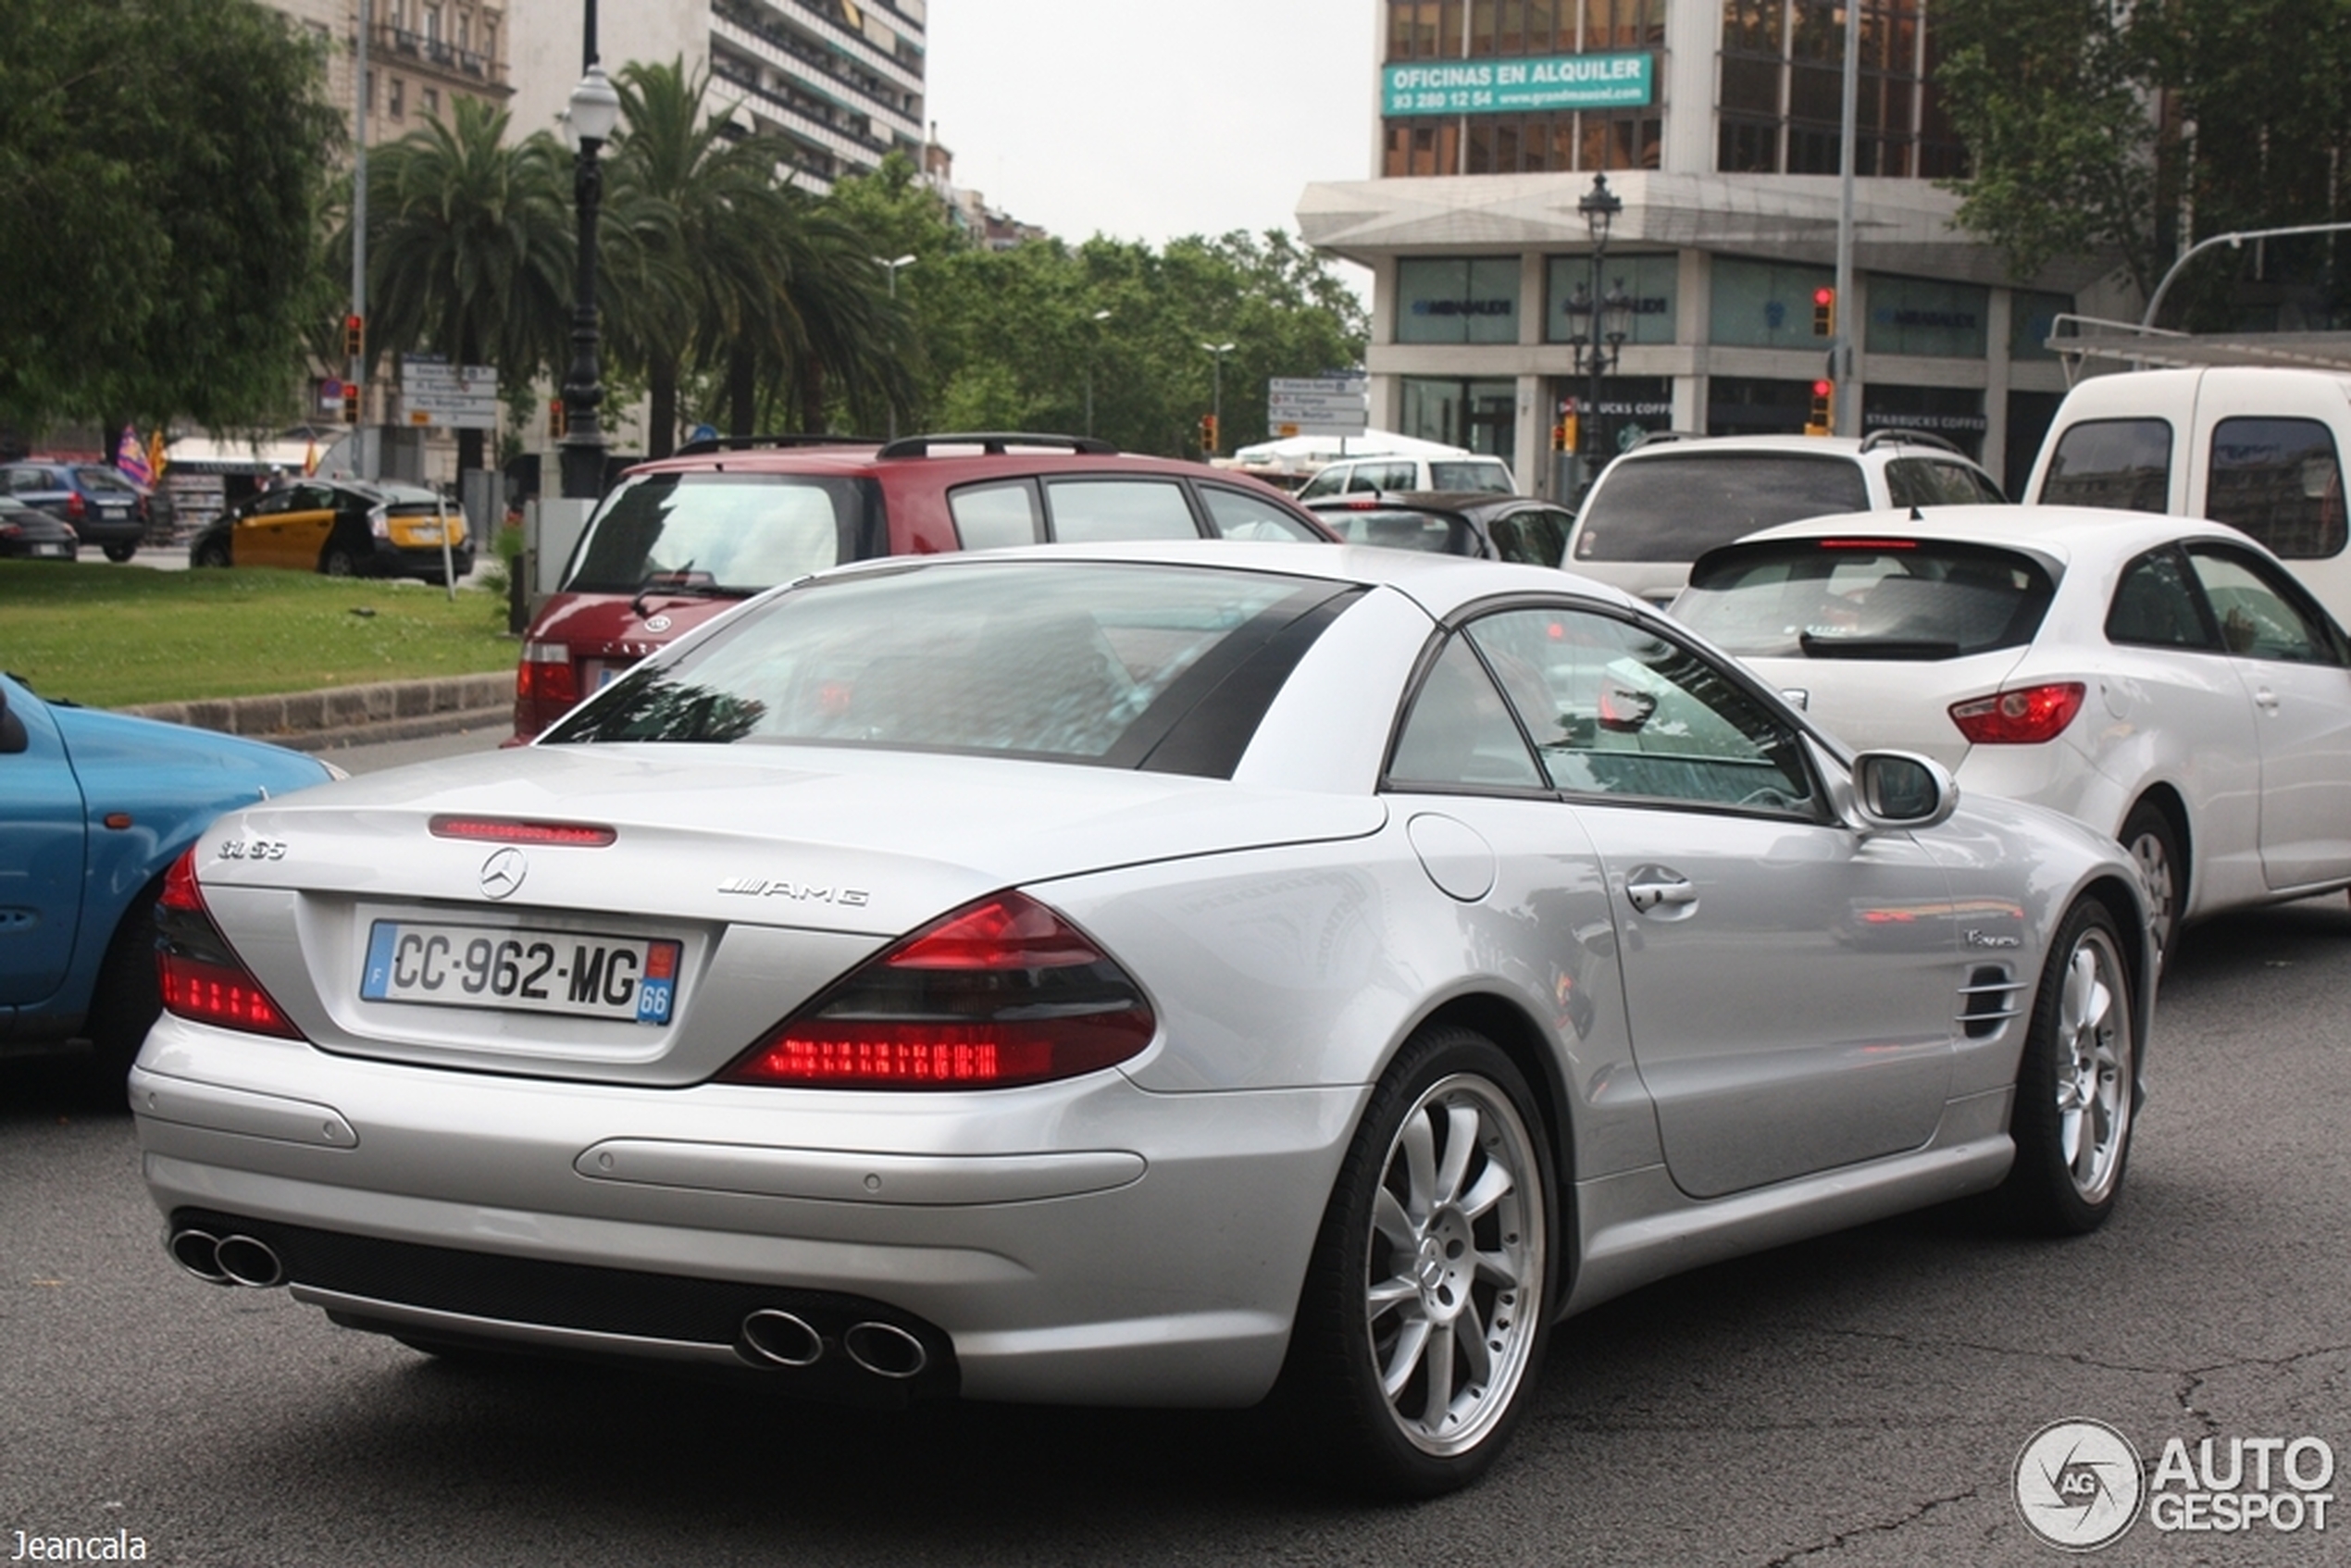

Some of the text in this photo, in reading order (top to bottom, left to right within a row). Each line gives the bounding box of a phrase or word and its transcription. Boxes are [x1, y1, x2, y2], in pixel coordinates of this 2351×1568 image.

[1393, 59, 1641, 90] OFICINAS EN ALQUILER
[1393, 93, 1412, 109] 93
[1450, 91, 1470, 106] 12
[1472, 90, 1492, 106] 54
[218, 840, 245, 860] SL
[765, 881, 870, 907] AMG
[371, 967, 382, 985] F
[393, 933, 639, 1006] CC-962-MG
[640, 987, 669, 1014] 66
